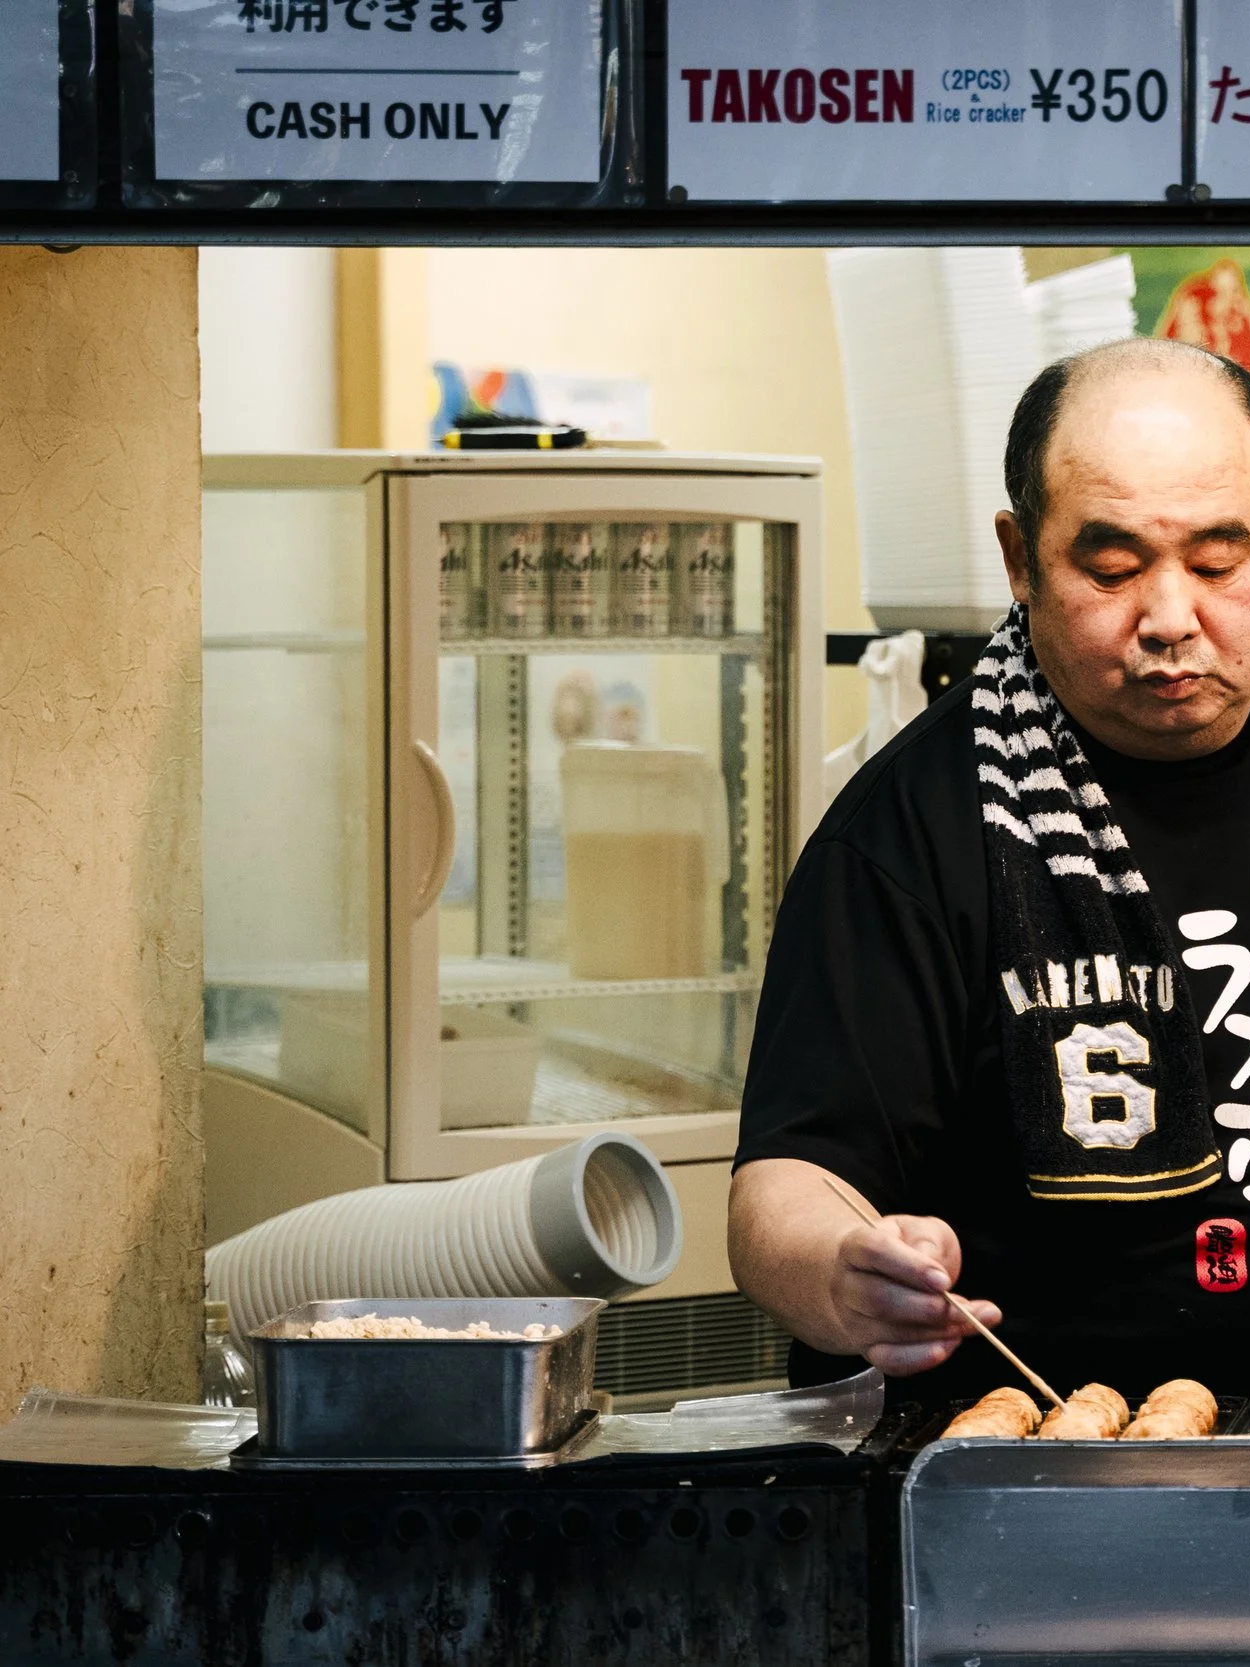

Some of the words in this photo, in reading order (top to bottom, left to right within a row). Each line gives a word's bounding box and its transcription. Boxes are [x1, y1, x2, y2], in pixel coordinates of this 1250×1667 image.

[238, 0, 518, 33] 利用できます
[681, 68, 914, 124] TAKOSEN
[942, 69, 1010, 92] (2PCS)
[1029, 68, 1169, 122] ¥350
[246, 101, 370, 139] CASH
[384, 102, 511, 140] ONLY
[926, 103, 961, 123] Rice
[968, 103, 1027, 123] cracker
[1054, 1022, 1157, 1150] 6
